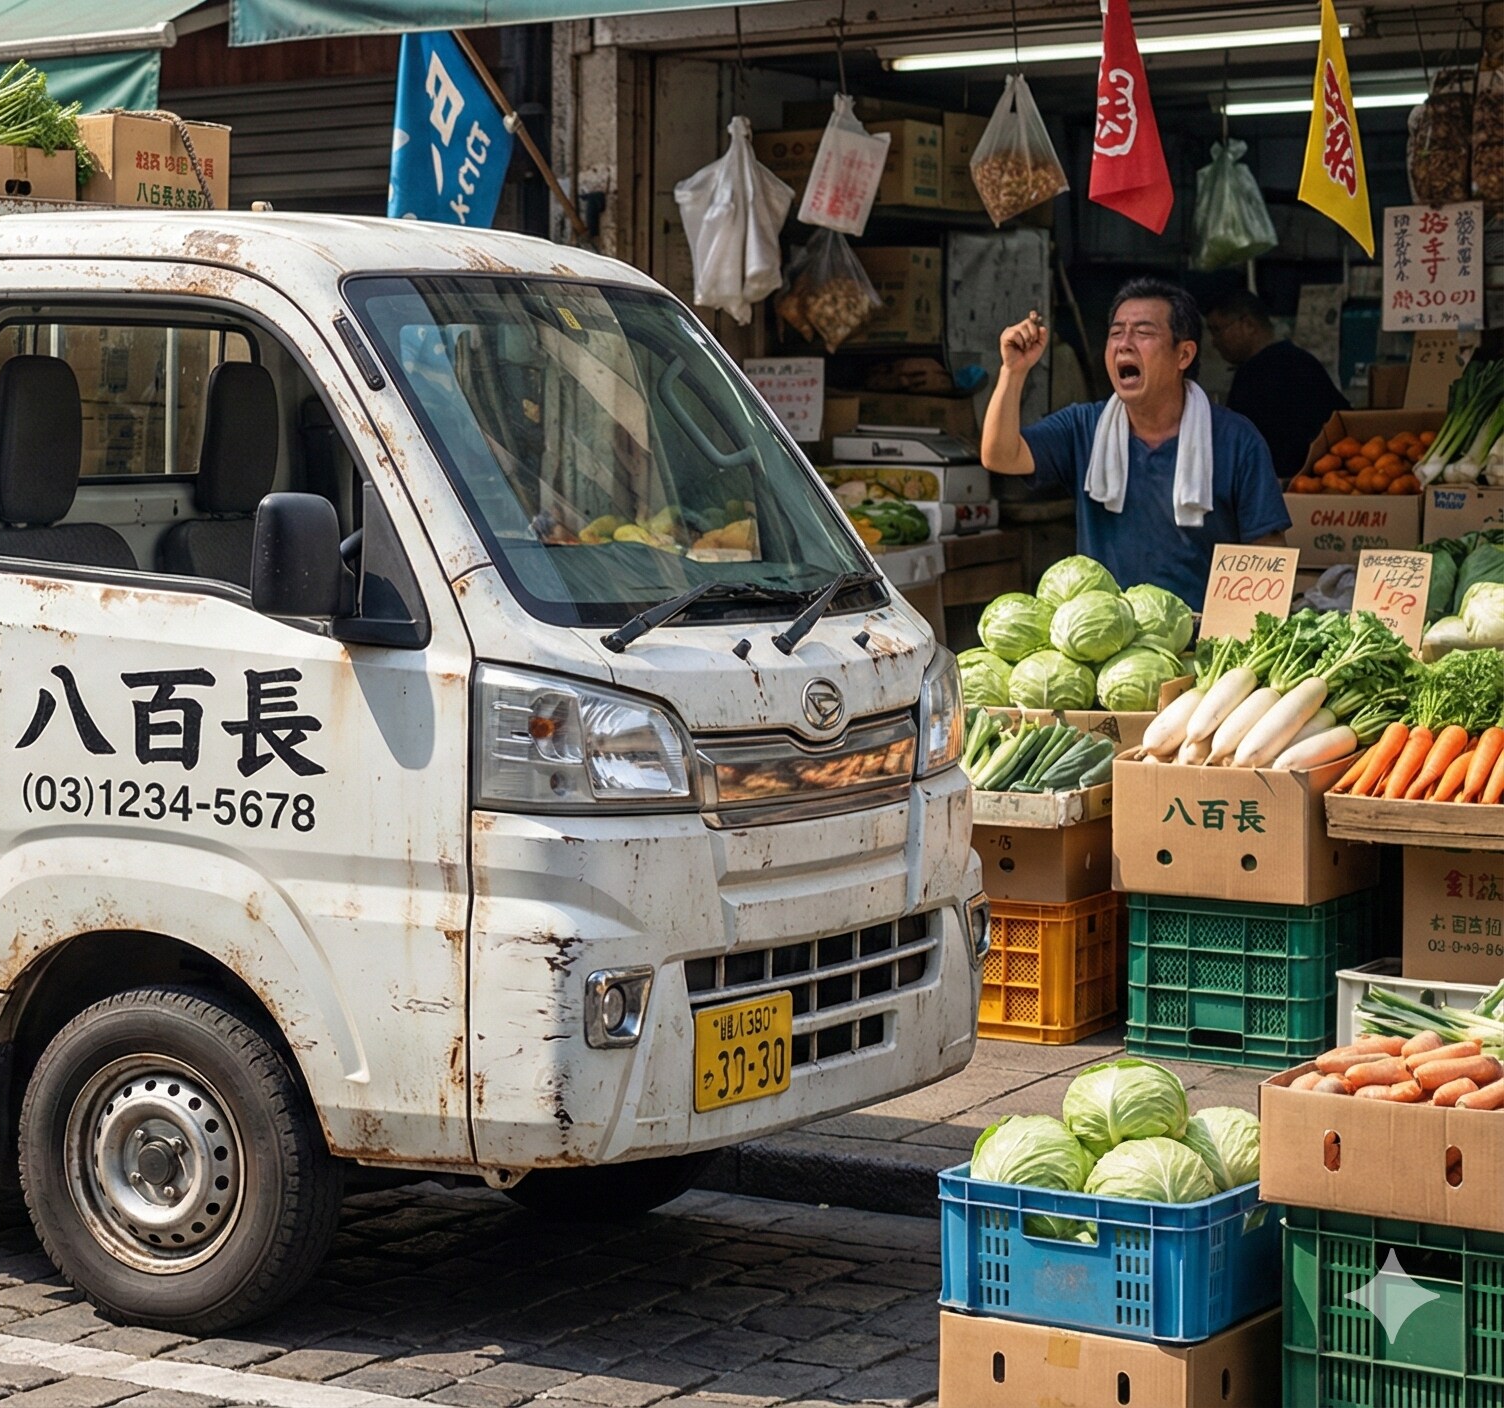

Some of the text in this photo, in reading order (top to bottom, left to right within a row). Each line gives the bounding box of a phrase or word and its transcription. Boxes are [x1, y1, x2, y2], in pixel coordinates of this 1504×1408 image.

[14, 664, 329, 778] 八百長
[22, 771, 317, 832] (03)1234-5678
[1162, 797, 1267, 833] 八百長
